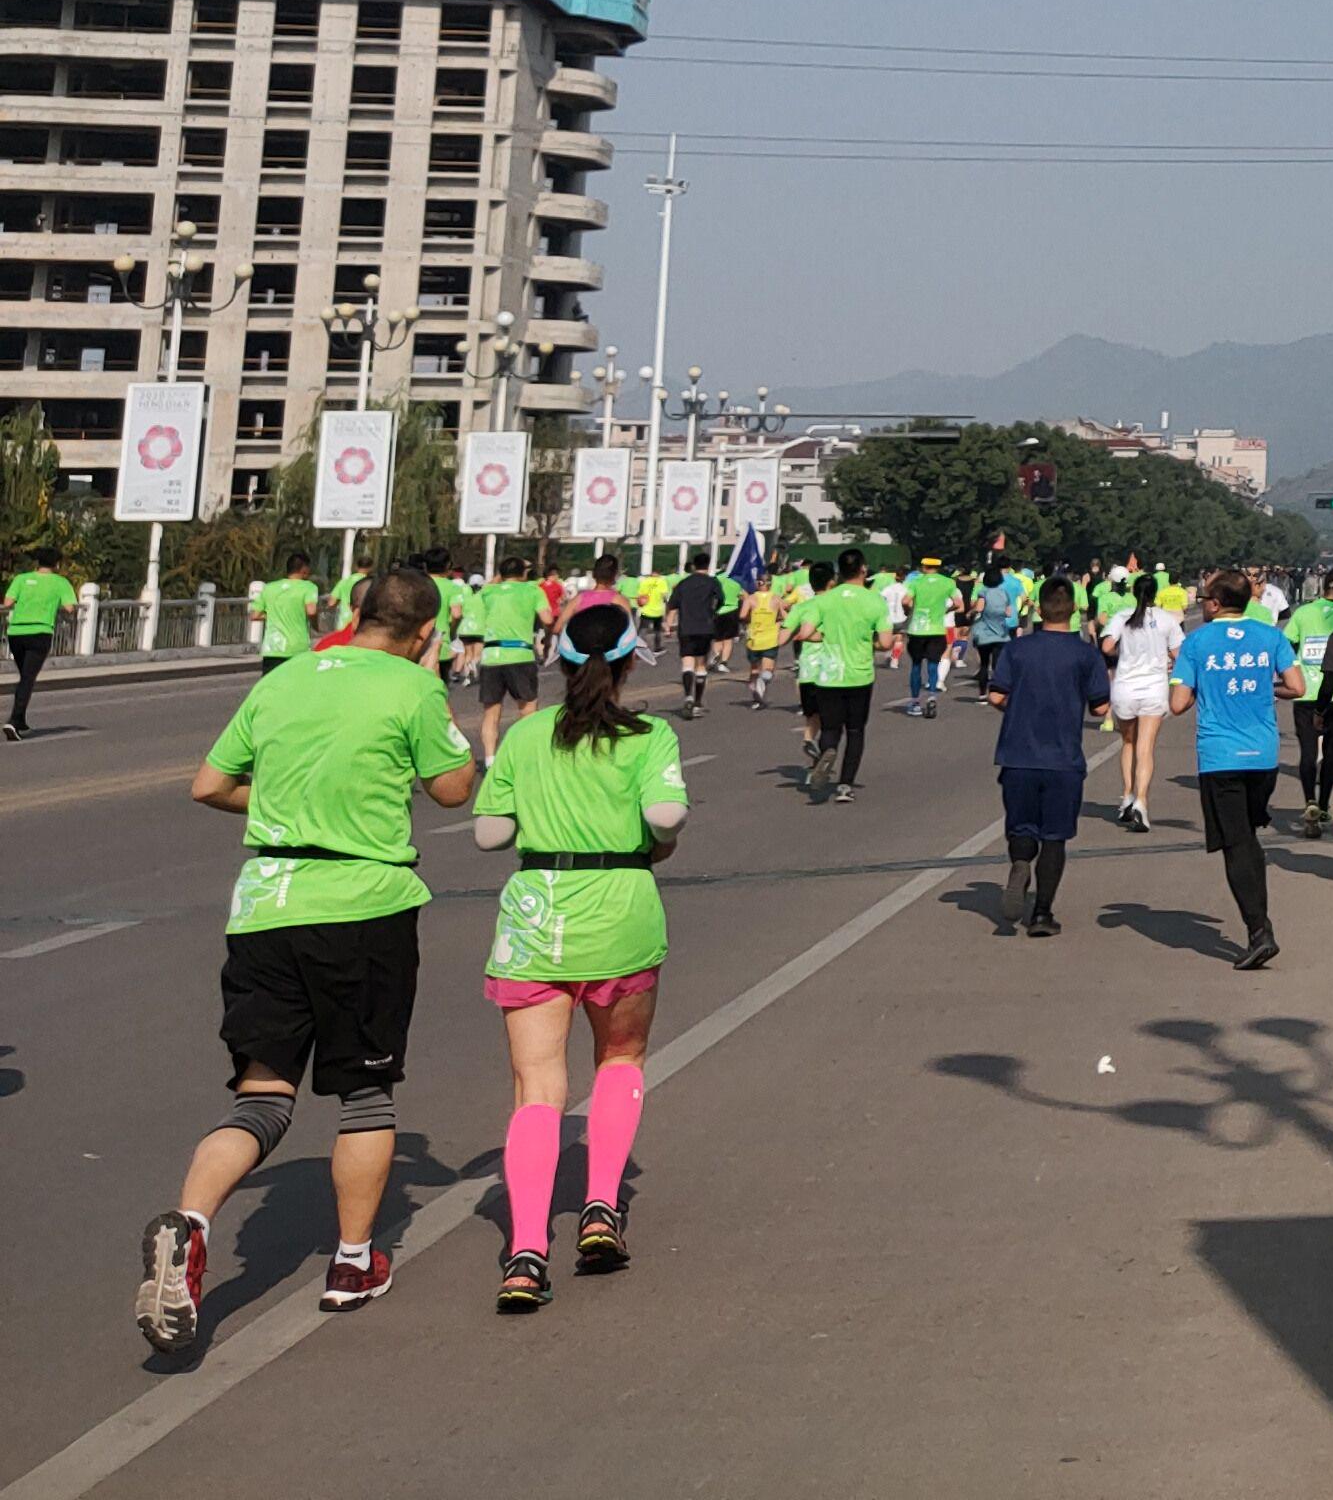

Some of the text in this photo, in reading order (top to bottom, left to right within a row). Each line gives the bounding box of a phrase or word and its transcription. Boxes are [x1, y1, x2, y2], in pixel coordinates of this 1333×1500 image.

[1205, 651, 1270, 672] 天翼跑团
[1226, 677, 1257, 696] 东阳
